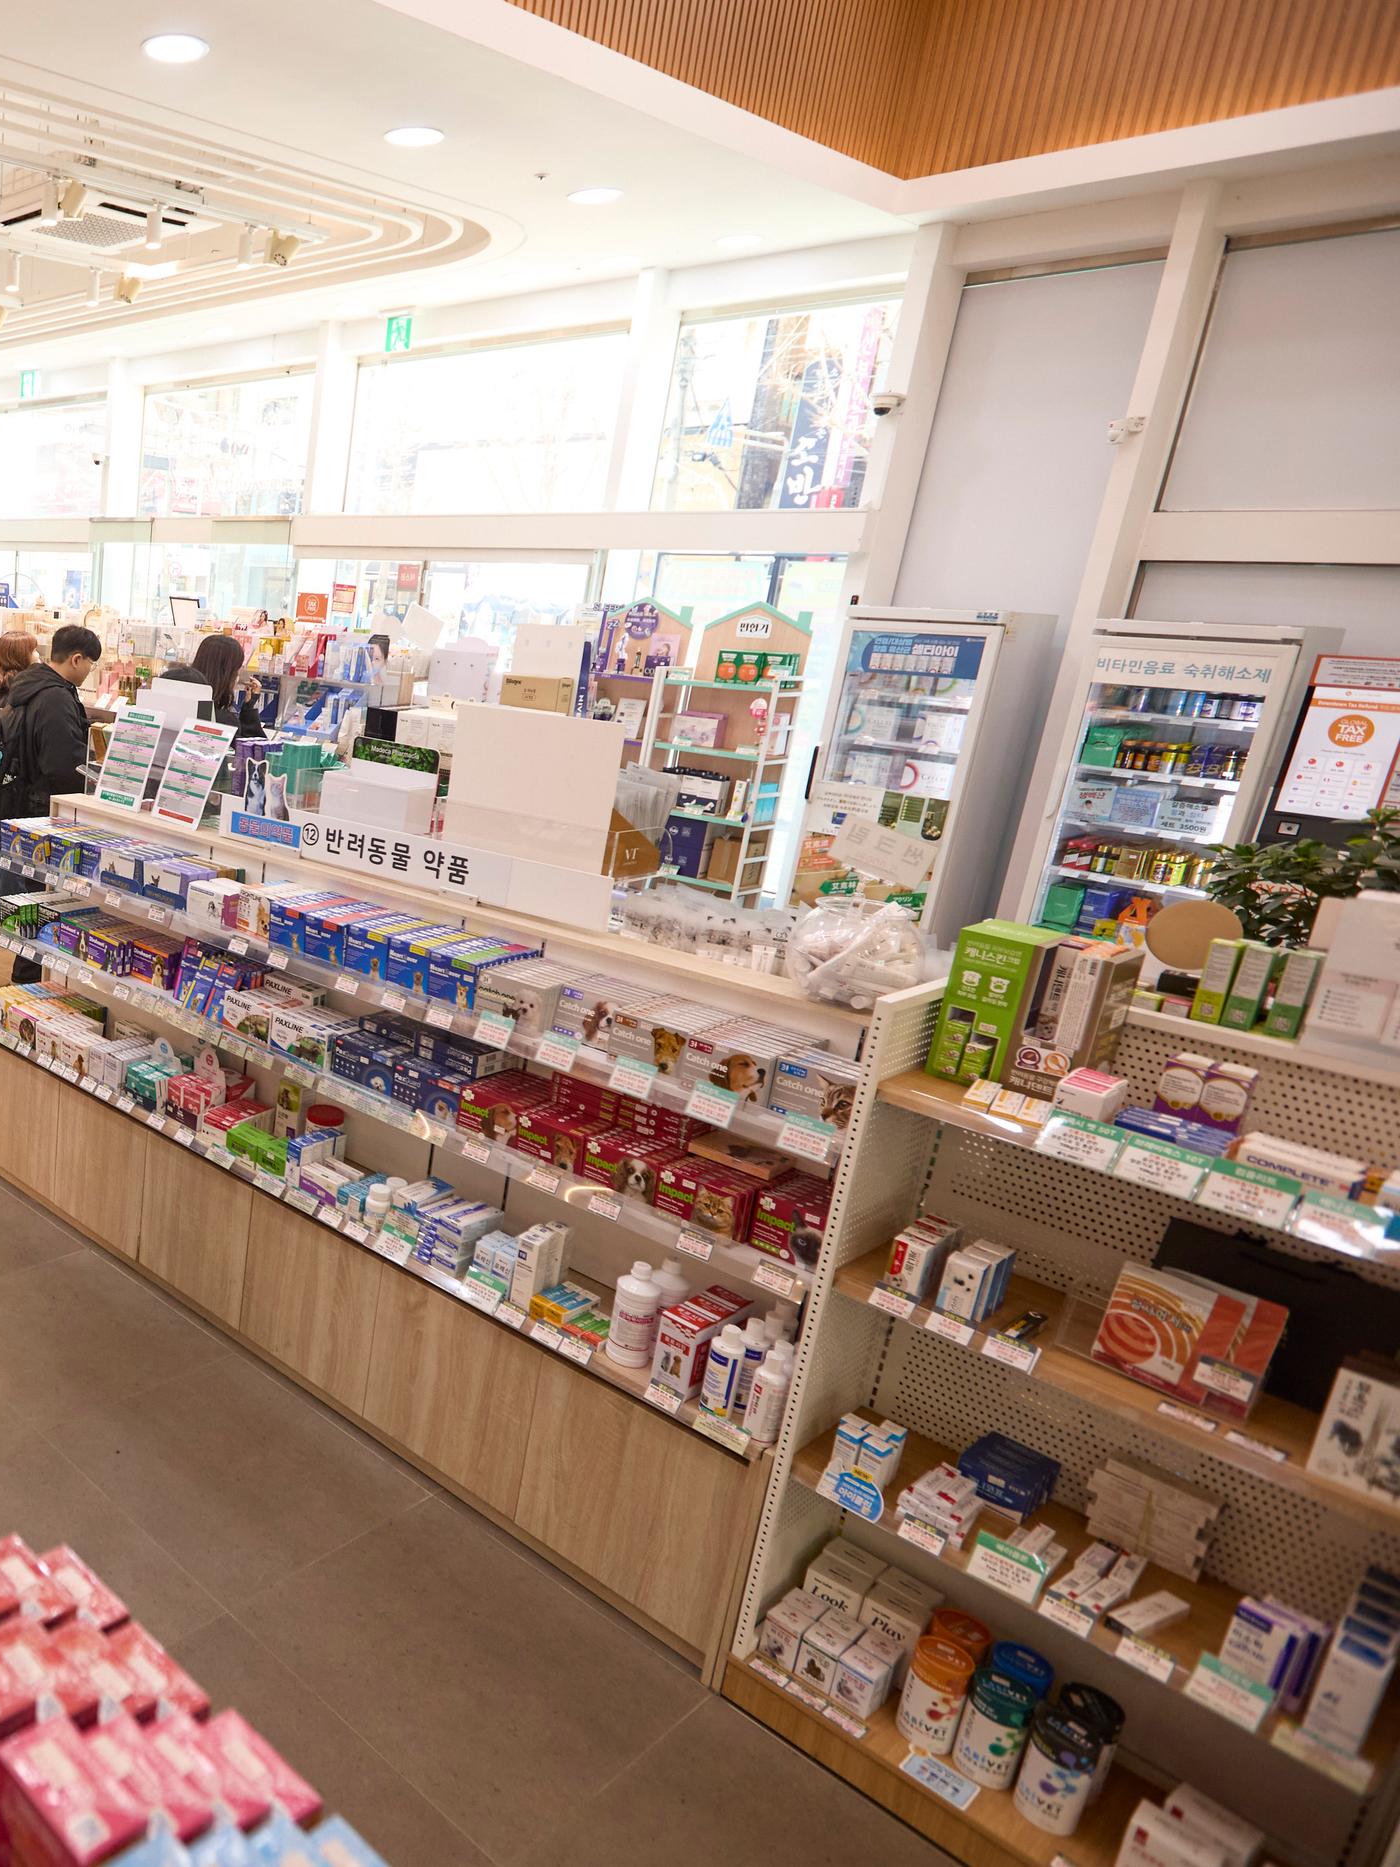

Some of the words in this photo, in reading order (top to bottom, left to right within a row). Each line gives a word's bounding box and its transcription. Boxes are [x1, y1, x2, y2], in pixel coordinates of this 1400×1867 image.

[1096, 657, 1176, 681] 비타민음료
[1183, 664, 1272, 684] 숙취해소제
[1335, 734, 1363, 743] FREE
[1338, 725, 1366, 735] TAX
[238, 816, 294, 844] 동물의약품
[325, 828, 412, 871] 반려동물
[423, 849, 469, 885] 약품
[265, 979, 292, 995] PAXLINE
[226, 995, 251, 1011] PAXLINE
[559, 999, 579, 1013] Catch
[580, 1006, 596, 1017] one
[275, 1016, 303, 1034] PAXLINE
[612, 1027, 634, 1043] Catch
[686, 1052, 710, 1068] Catch
[711, 1061, 729, 1073] one
[776, 1076, 802, 1093] Catch
[804, 1084, 823, 1097] one
[460, 1100, 489, 1119] Impact
[518, 1126, 548, 1145] Impact
[585, 1152, 617, 1173] Impact
[1247, 1156, 1329, 1185] COMPLETE
[658, 1181, 694, 1204] Impact
[756, 1208, 796, 1233] Impact
[810, 1584, 850, 1613] Look
[870, 1615, 906, 1642] Play
